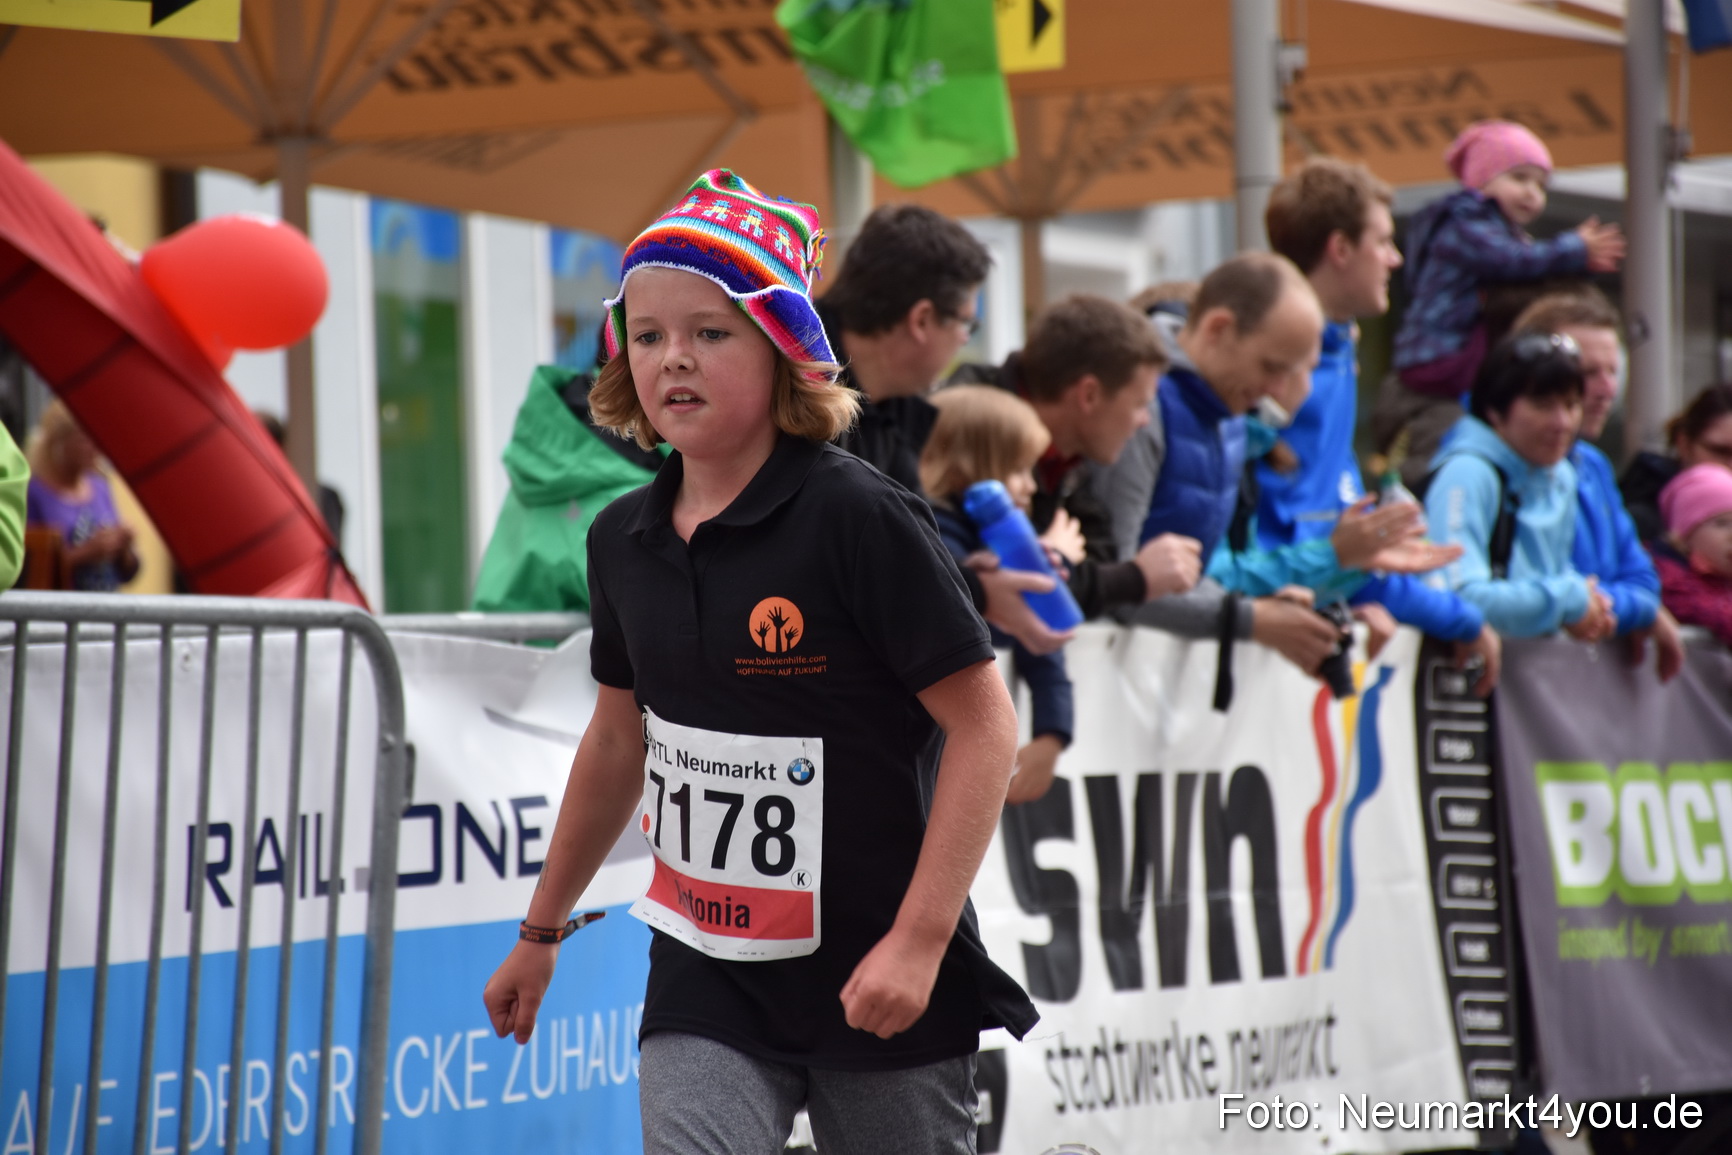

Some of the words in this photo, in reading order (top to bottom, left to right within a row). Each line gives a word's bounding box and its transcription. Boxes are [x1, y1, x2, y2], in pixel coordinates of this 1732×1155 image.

[735, 655, 827, 666] www.bolivienhilfe.com
[737, 667, 776, 676] HOFFNUNG
[777, 668, 792, 676] AUF
[794, 665, 827, 675] ZUKUNFT
[676, 749, 777, 781] Neumarkt
[650, 768, 796, 877] 7178
[797, 872, 806, 886] K
[1045, 1017, 1219, 1115] stadtwerke
[1226, 1002, 1339, 1091] neumarkt
